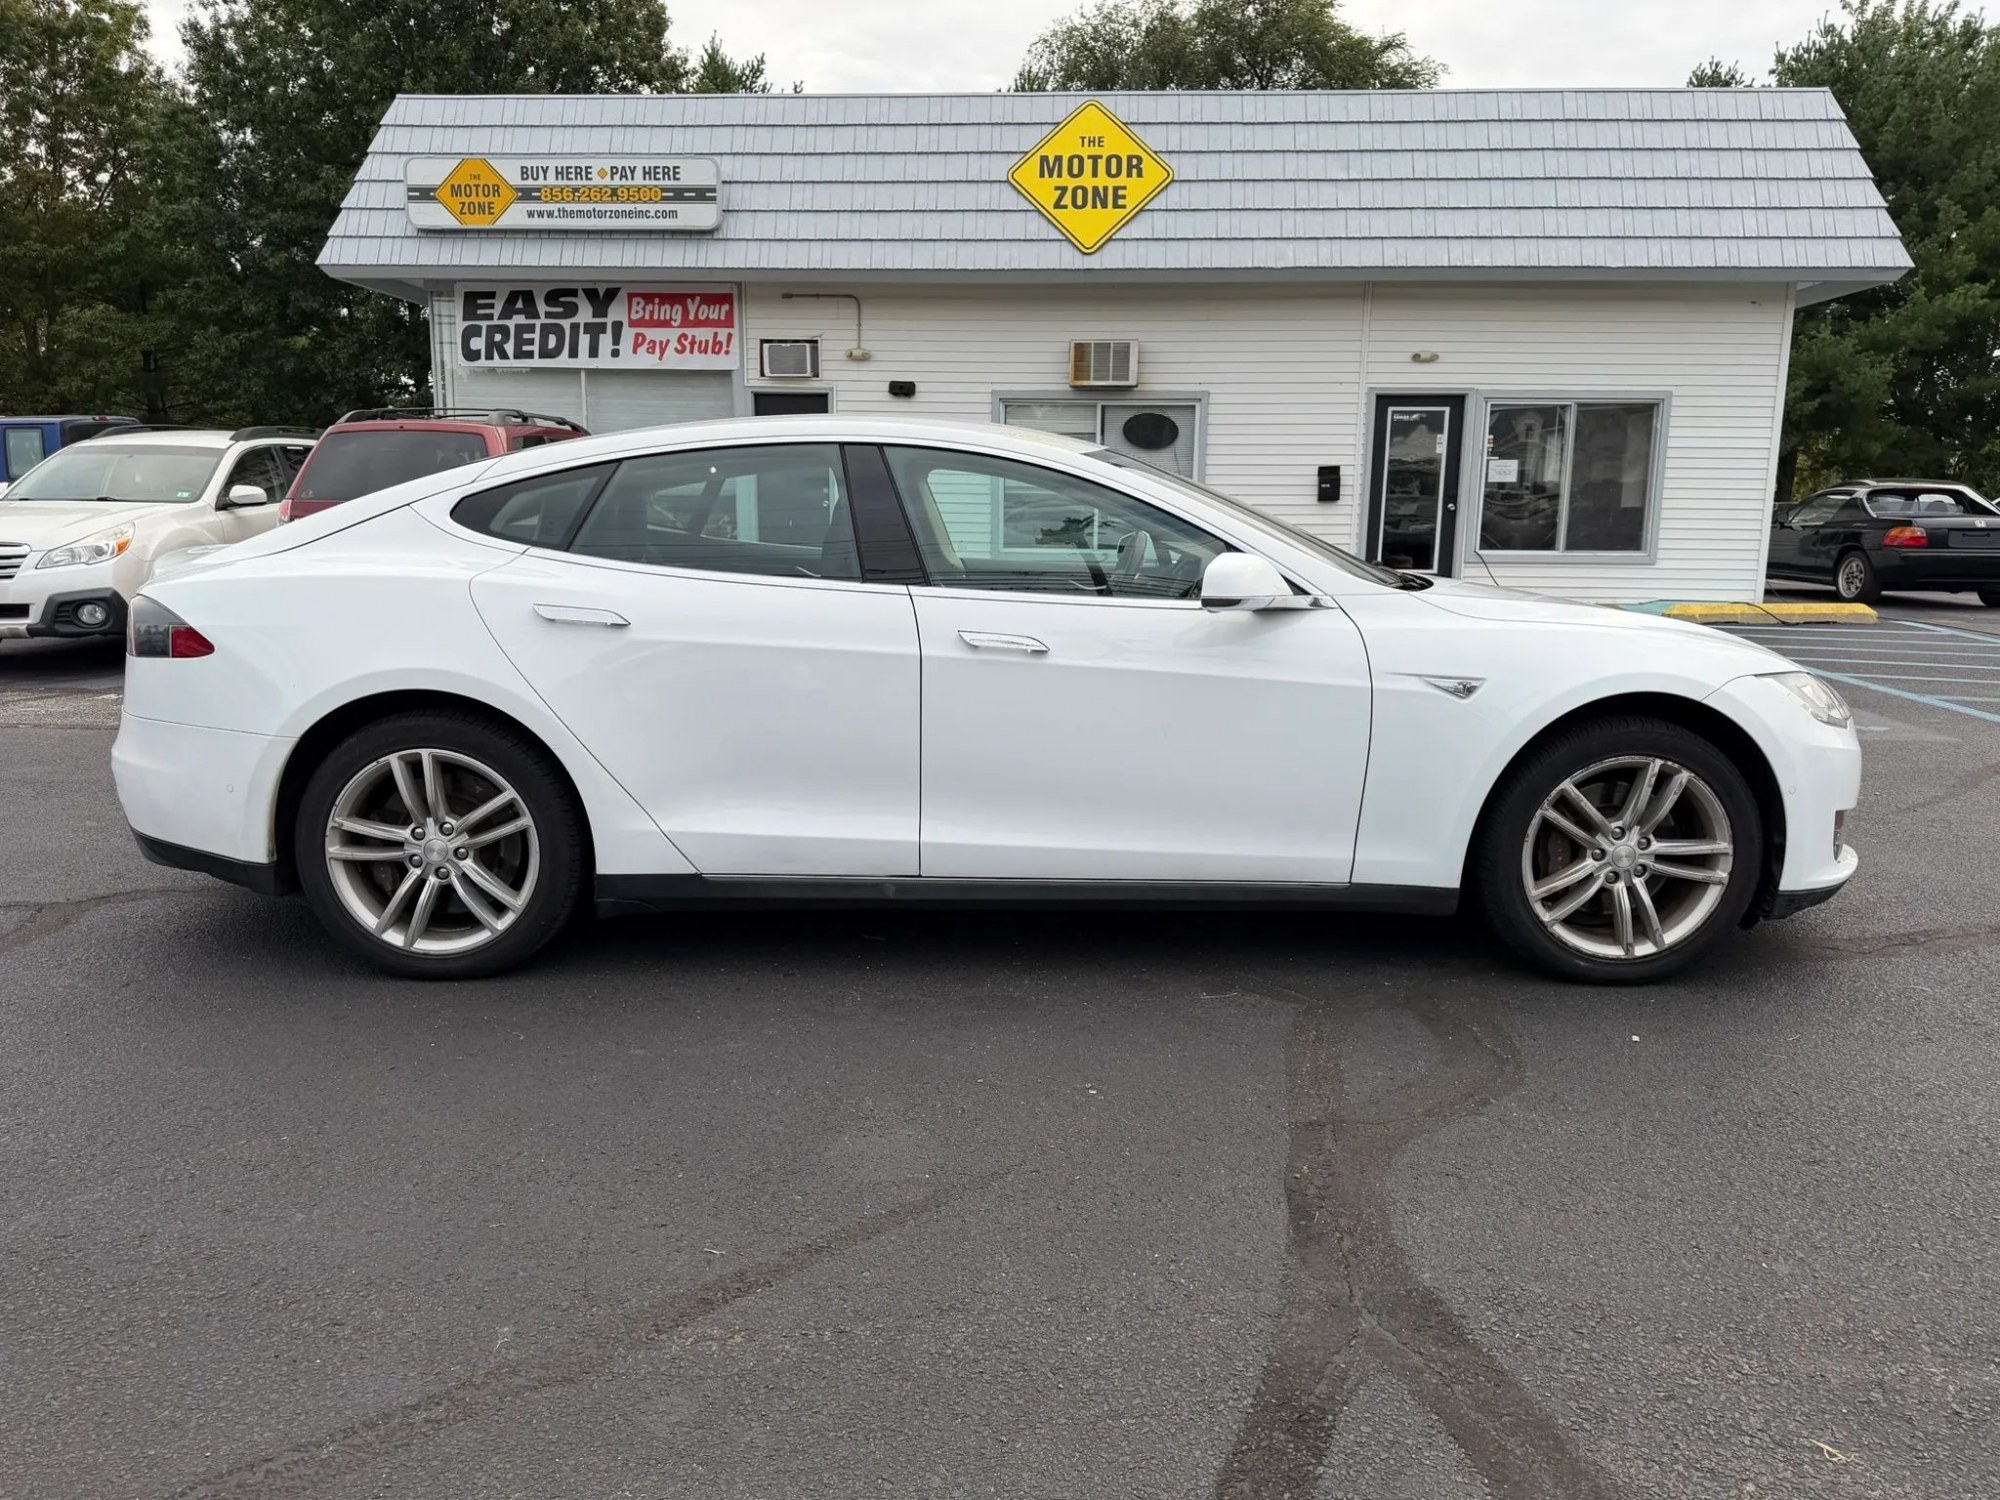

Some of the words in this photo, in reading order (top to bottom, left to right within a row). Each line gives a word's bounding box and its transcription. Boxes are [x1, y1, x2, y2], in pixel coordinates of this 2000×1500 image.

[1079, 136, 1105, 147] THE
[520, 166, 549, 181] BUY
[554, 166, 593, 181] HERE
[610, 166, 637, 181] PAY
[642, 166, 681, 181] HERE
[1039, 154, 1144, 179] MOTOR
[450, 184, 501, 198] MOTOR
[541, 187, 663, 203] 856.262.9500
[1053, 185, 1127, 210] ZONE
[458, 201, 495, 216] ZONE
[526, 207, 678, 220] www.themotorzoneinc.com
[462, 287, 623, 321] EASY
[629, 296, 683, 327] Bring
[686, 297, 731, 321] Your
[461, 320, 624, 362] CREDIT!
[632, 332, 670, 361] Pay
[673, 332, 733, 355] Stub!
